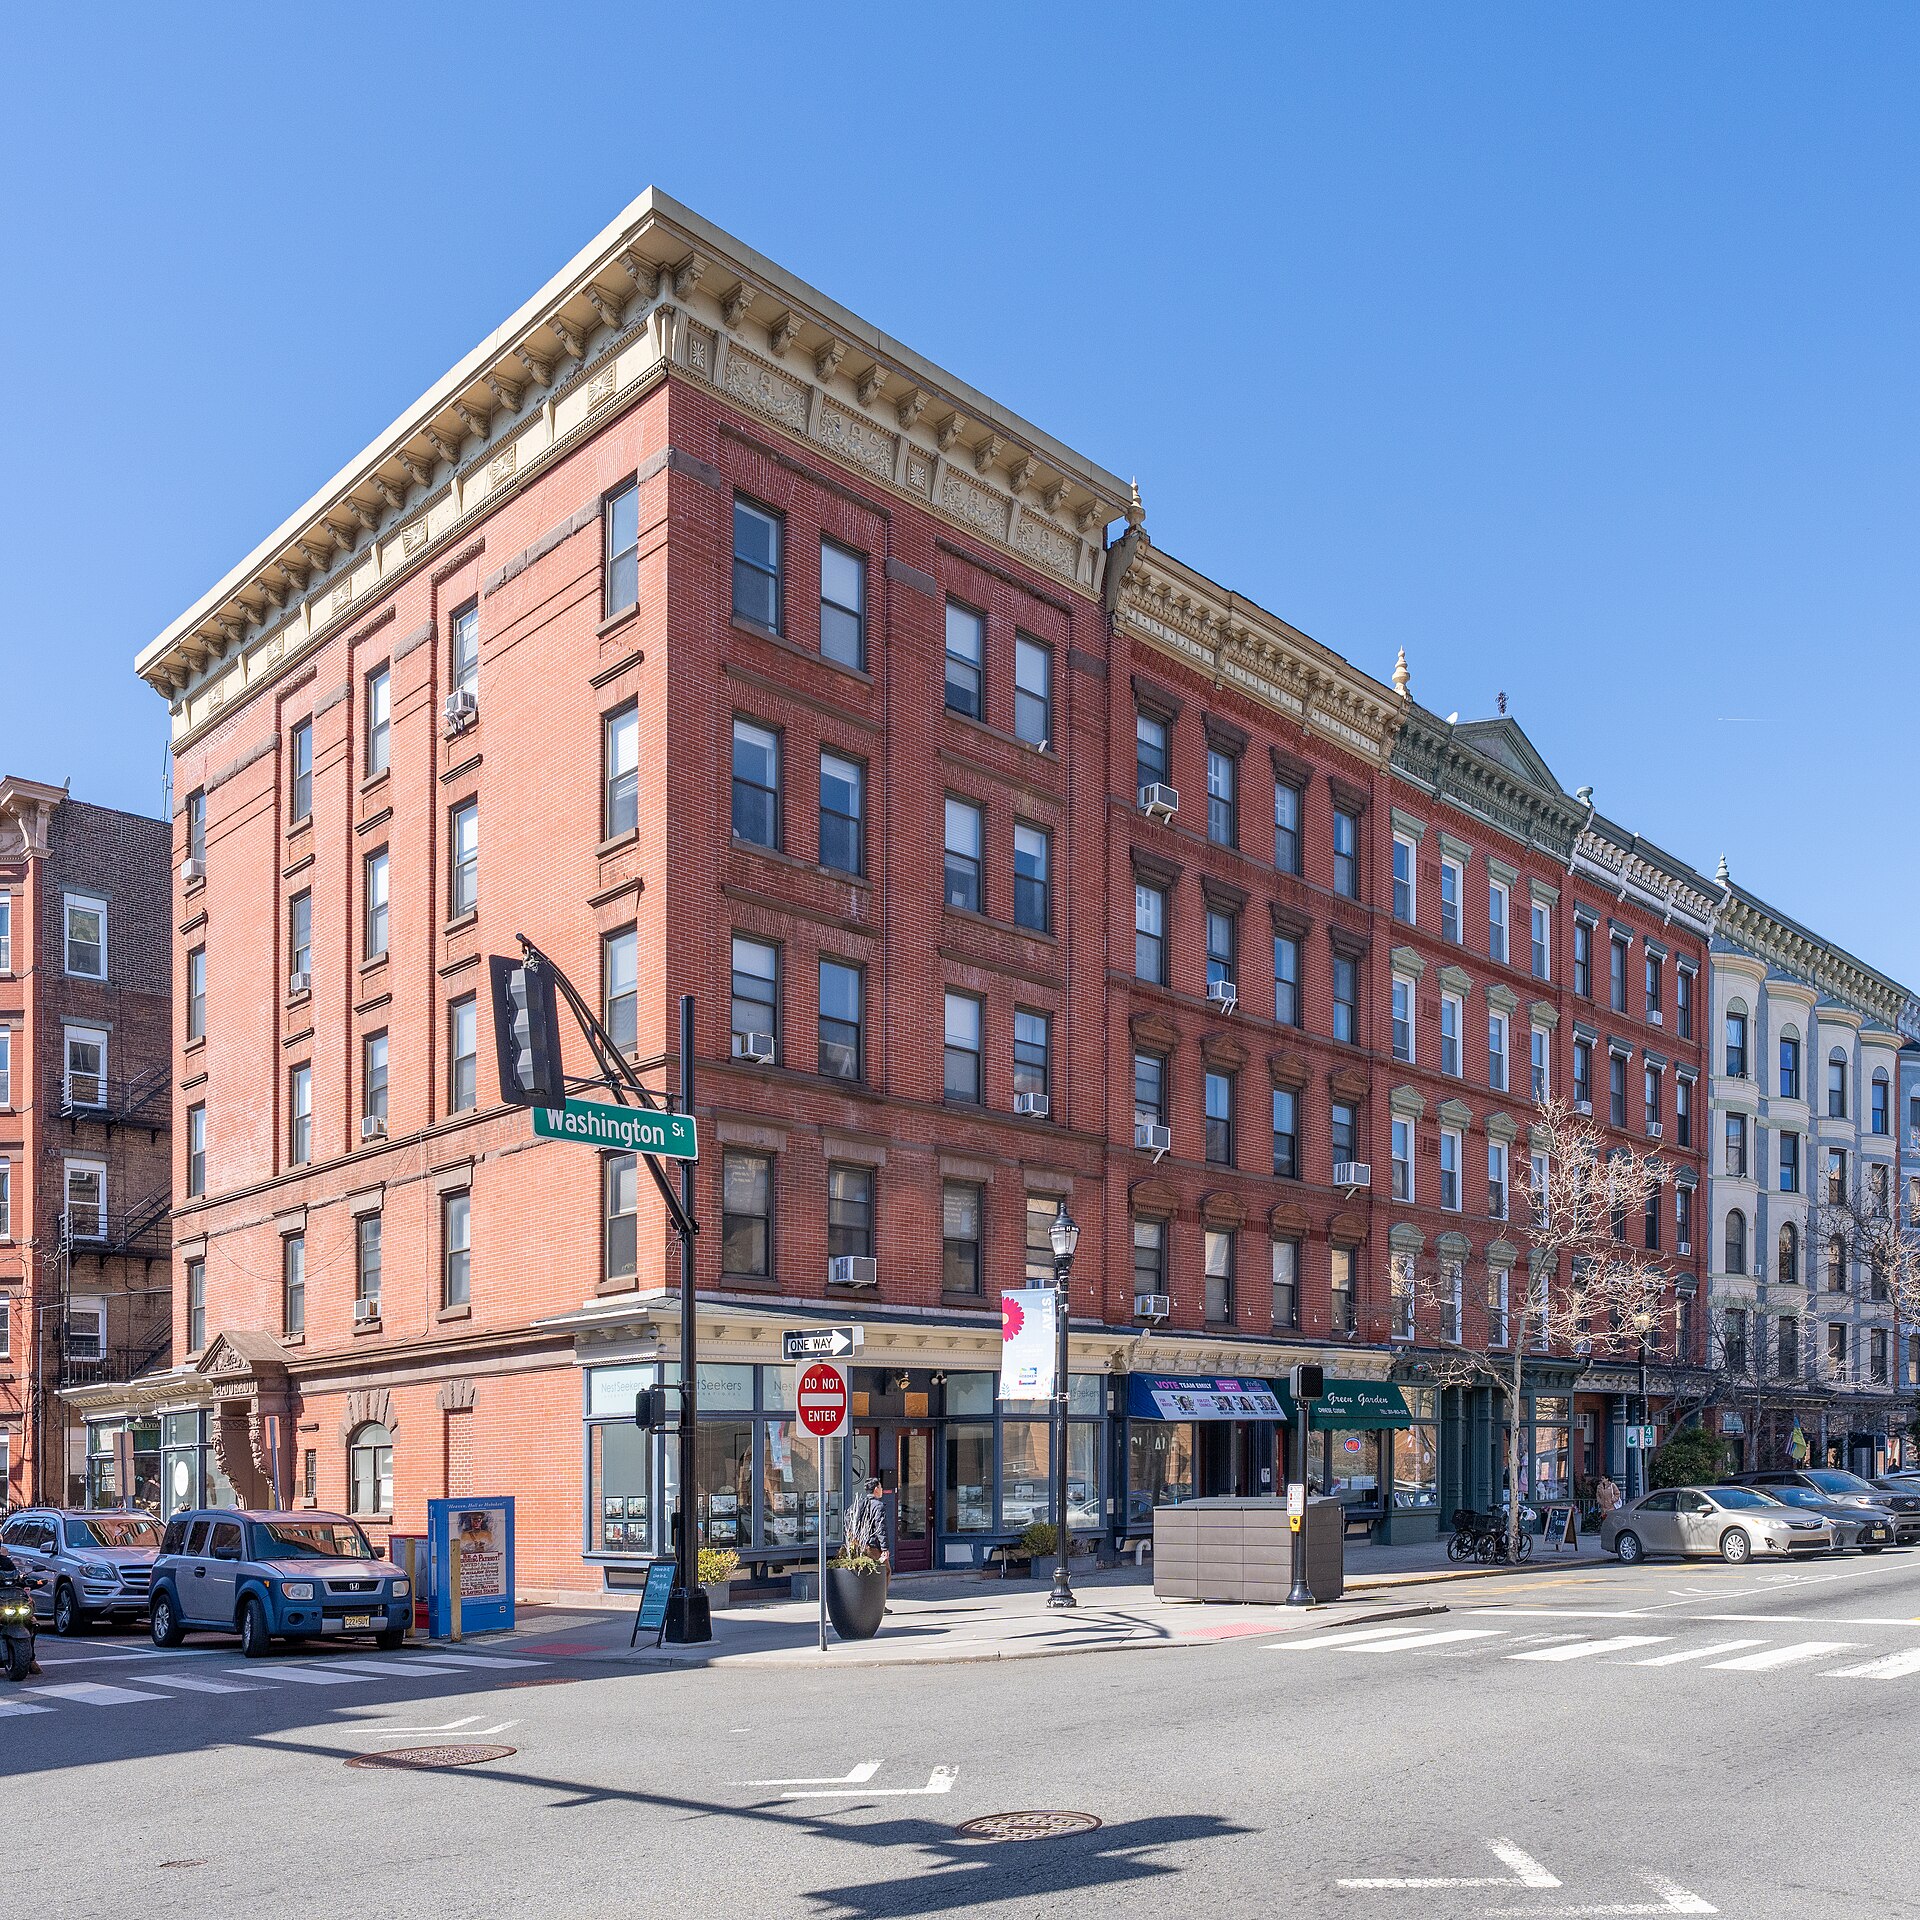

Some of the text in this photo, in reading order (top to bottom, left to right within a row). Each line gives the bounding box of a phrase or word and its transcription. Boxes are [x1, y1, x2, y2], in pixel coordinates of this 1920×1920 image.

[547, 1109, 685, 1147] Washington St
[1041, 1297, 1053, 1333] STAY.
[790, 1337, 833, 1351] ONE WAY
[601, 1381, 645, 1393] NestSeekers
[804, 1378, 840, 1390] DO NOT
[1155, 1380, 1180, 1389] VOTE
[1327, 1392, 1388, 1406] Green Garden
[808, 1410, 837, 1422] ENTER
[1645, 1427, 1652, 1436] 4
